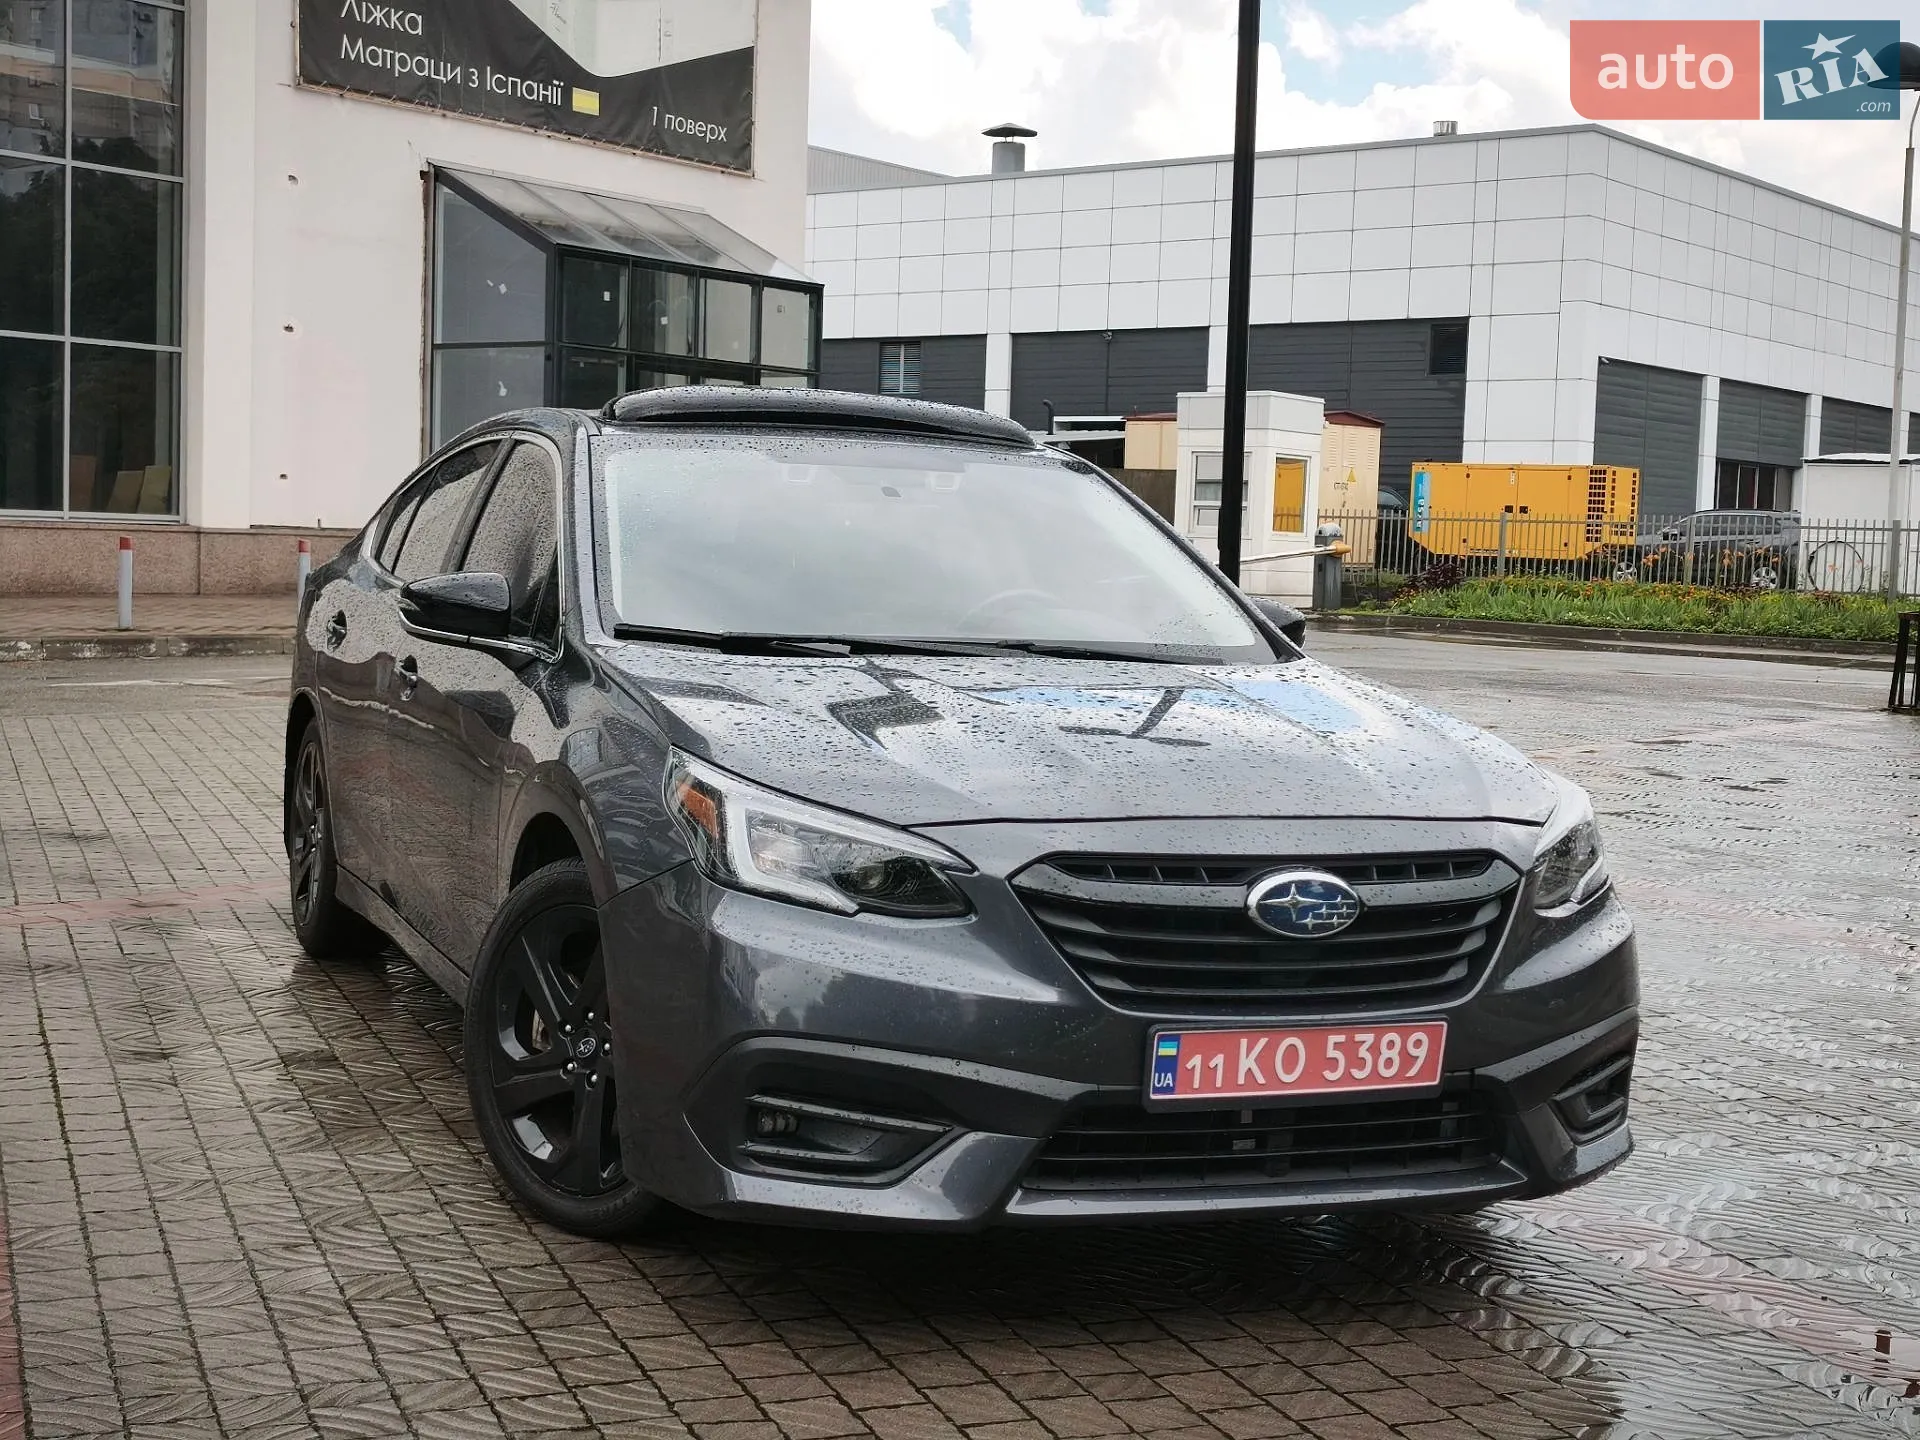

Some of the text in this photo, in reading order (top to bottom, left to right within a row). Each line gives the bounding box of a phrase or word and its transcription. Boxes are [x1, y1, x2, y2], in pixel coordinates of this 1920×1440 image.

[340, 0, 423, 36] Ліжка
[340, 33, 563, 106] Матраци з Іспанії
[652, 106, 728, 143] 1 поверх
[1322, 1031, 1429, 1081] 5389
[1154, 1072, 1174, 1088] UA
